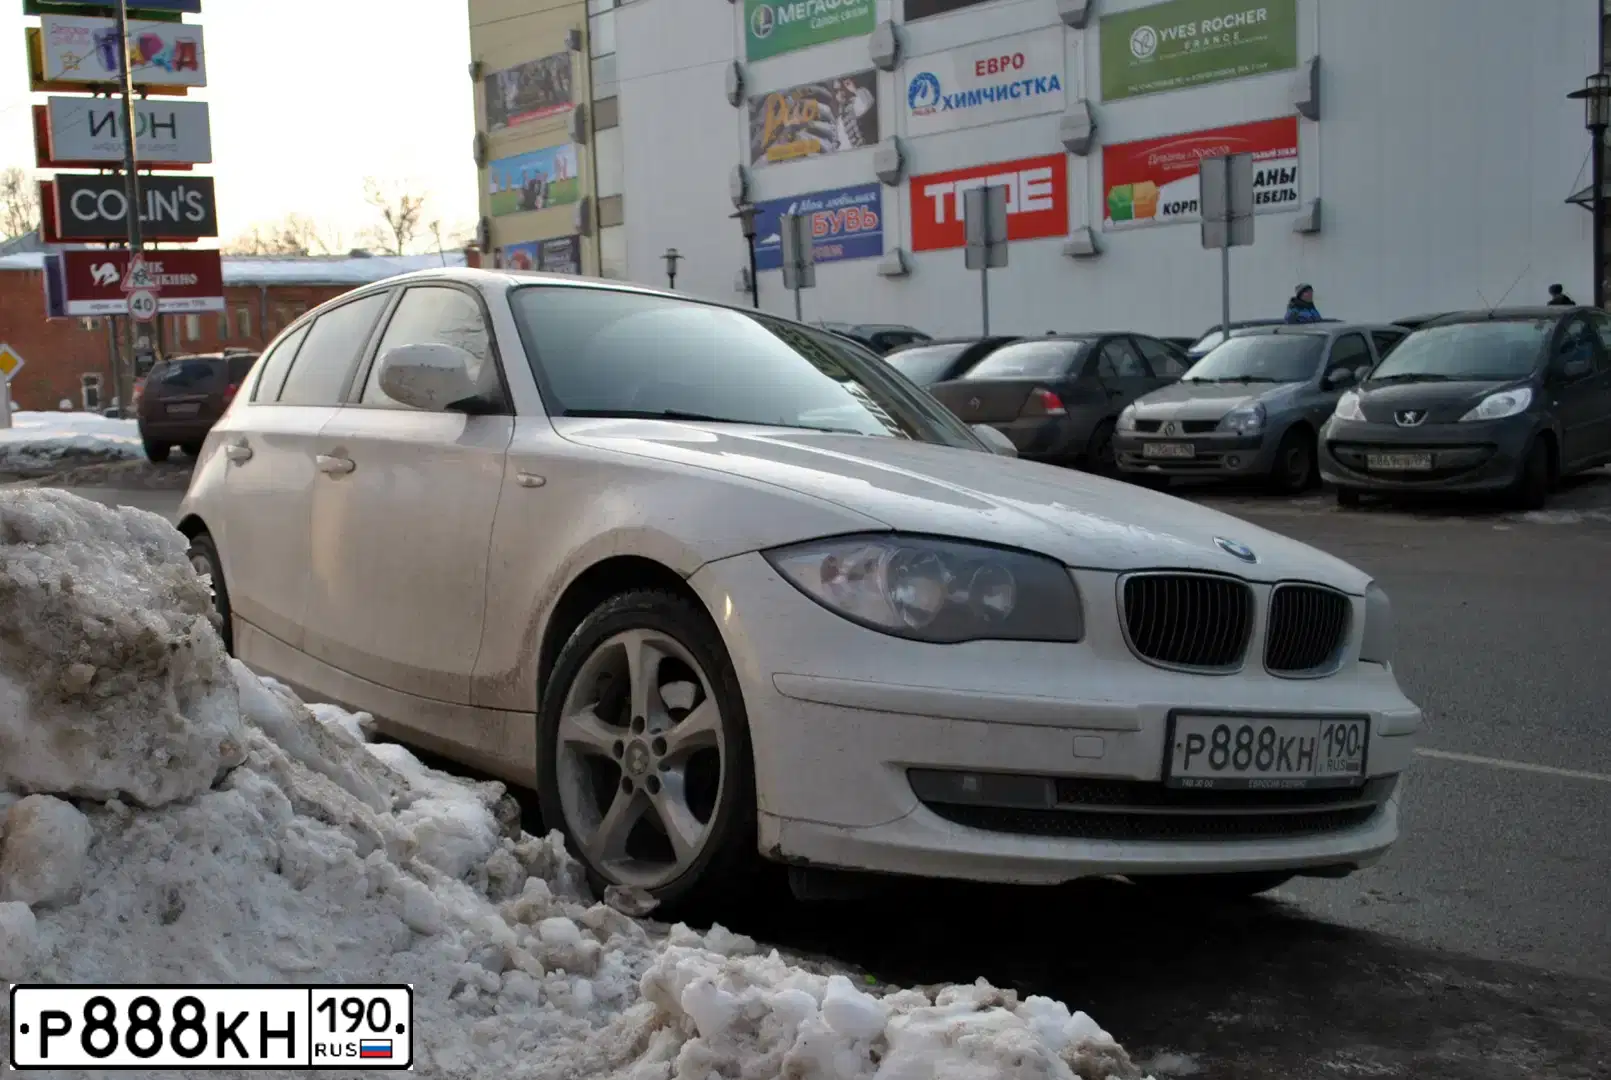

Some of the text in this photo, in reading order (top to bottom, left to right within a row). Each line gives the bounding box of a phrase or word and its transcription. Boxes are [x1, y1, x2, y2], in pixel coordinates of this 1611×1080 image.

[777, 0, 869, 25] МЕГАФ
[1159, 7, 1268, 42] YVES ROCHER
[974, 52, 1025, 77] ЕВРО
[941, 74, 1062, 112] ХИМЧИСТКА
[1253, 166, 1297, 188] АНЫ
[70, 185, 205, 221] COIN'S
[1163, 188, 1298, 216] КОРП ЕБЕЛЬ
[811, 204, 878, 238] БУВЬ
[133, 298, 154, 312] 40
[1183, 723, 1359, 772] Р888КН 190
